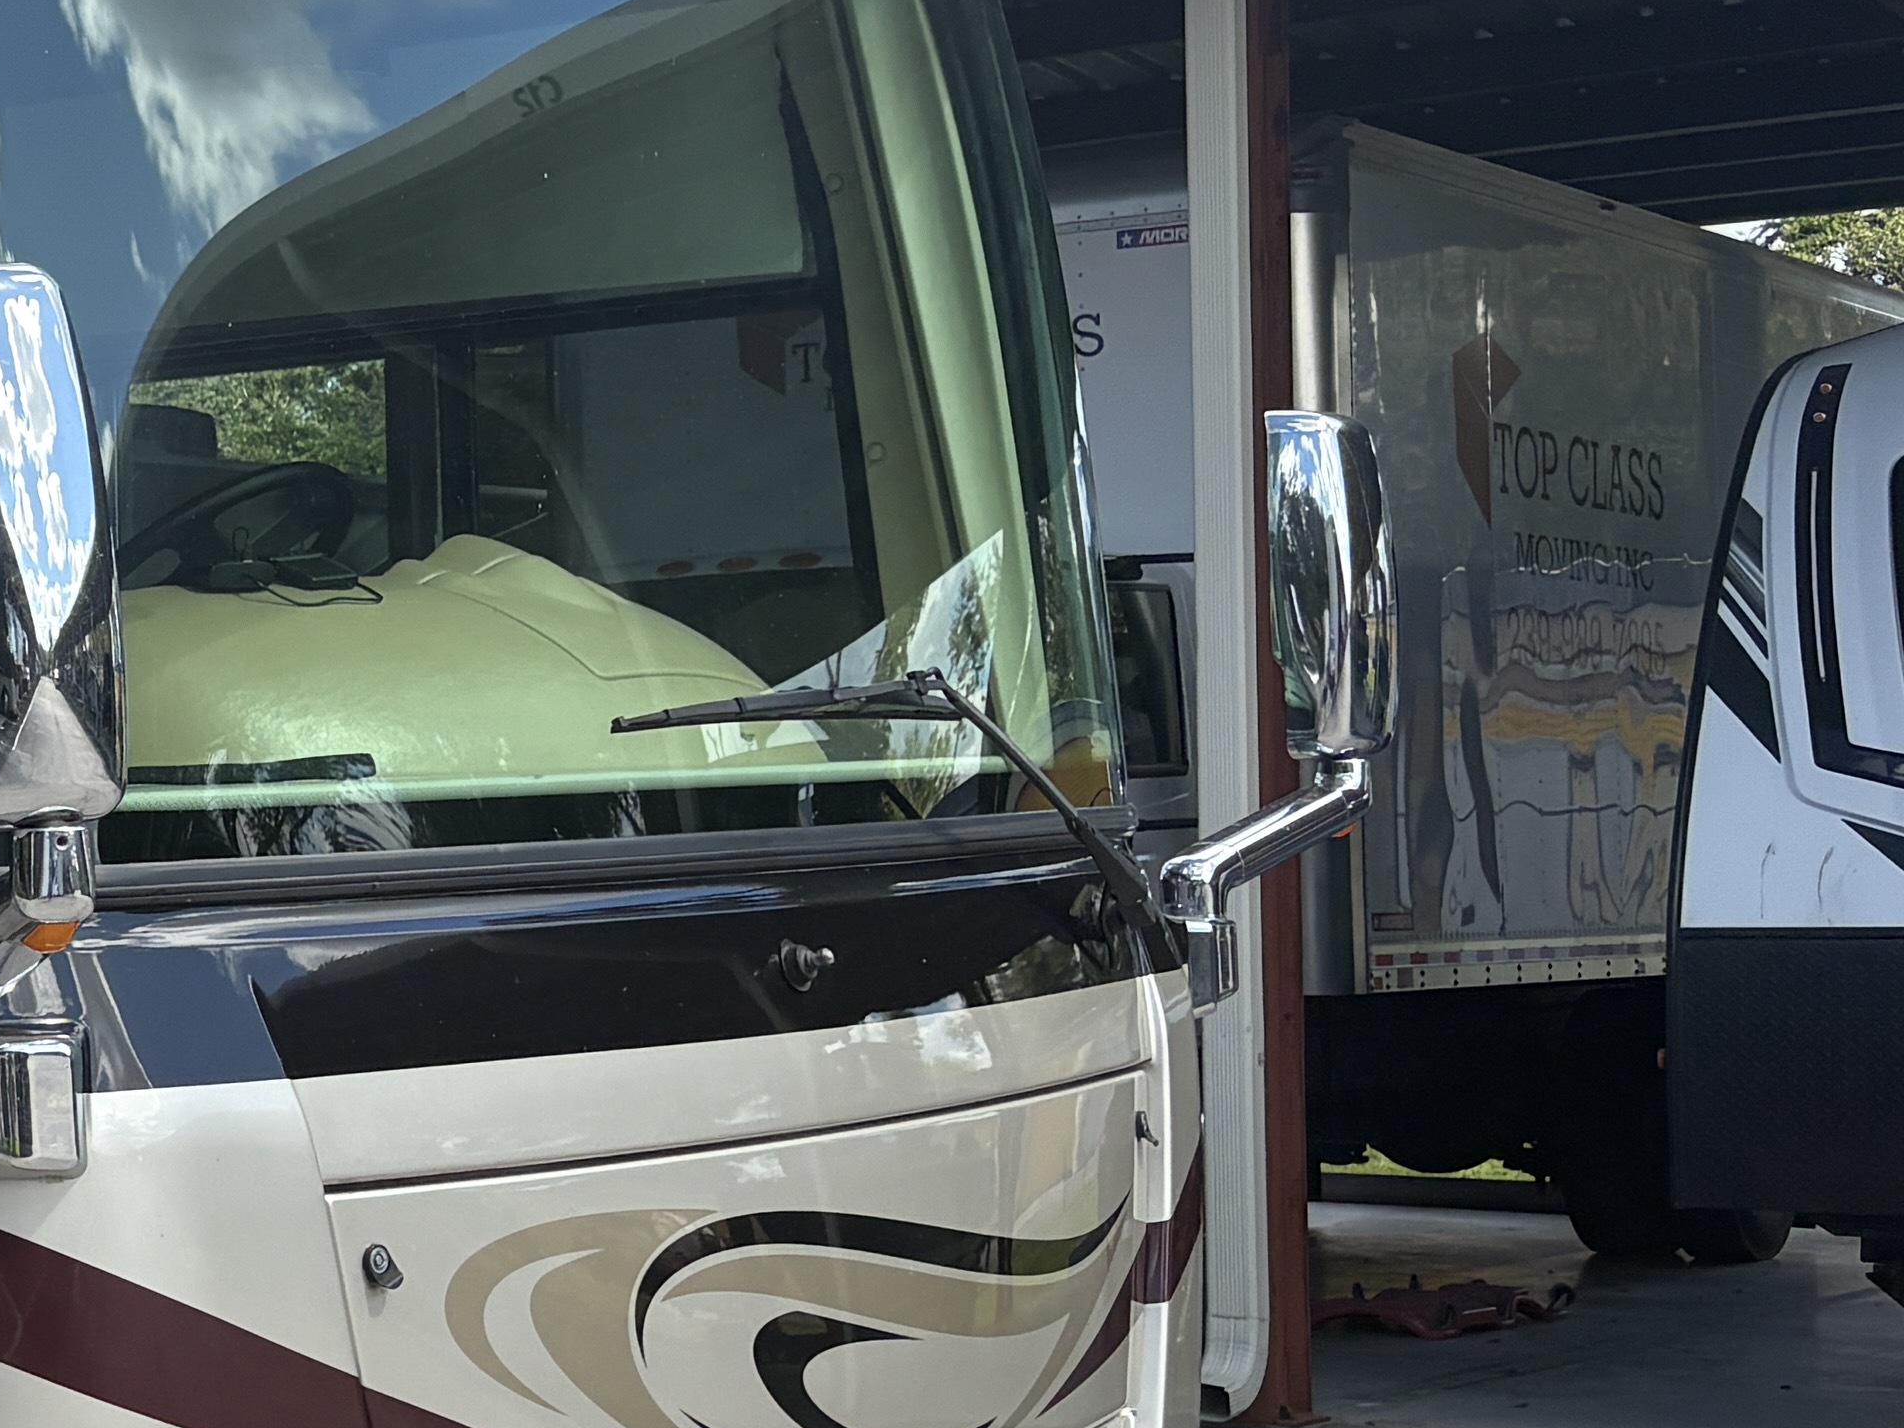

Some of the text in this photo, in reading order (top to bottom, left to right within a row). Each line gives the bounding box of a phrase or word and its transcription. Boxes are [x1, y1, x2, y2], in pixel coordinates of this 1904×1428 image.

[1493, 422, 1664, 521] TOP CLASS
[1514, 532, 1654, 591] MOVING INC
